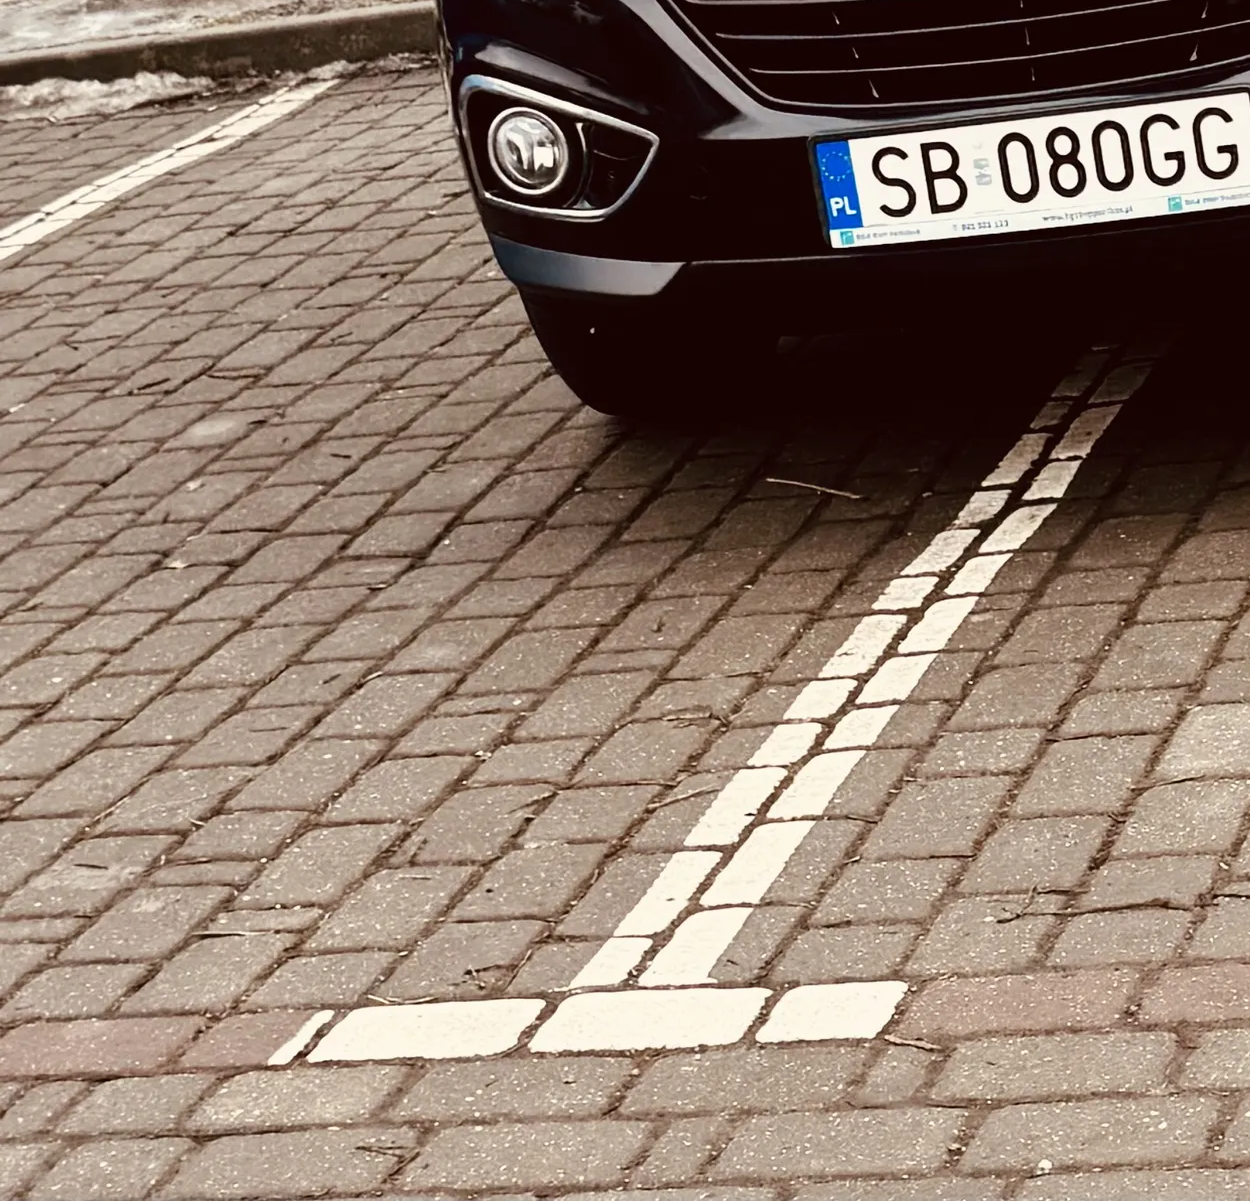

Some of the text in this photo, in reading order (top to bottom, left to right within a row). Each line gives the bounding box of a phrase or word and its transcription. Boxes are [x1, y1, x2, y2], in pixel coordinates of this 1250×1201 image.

[871, 107, 1239, 217] SB 080GG
[830, 196, 857, 216] PL
